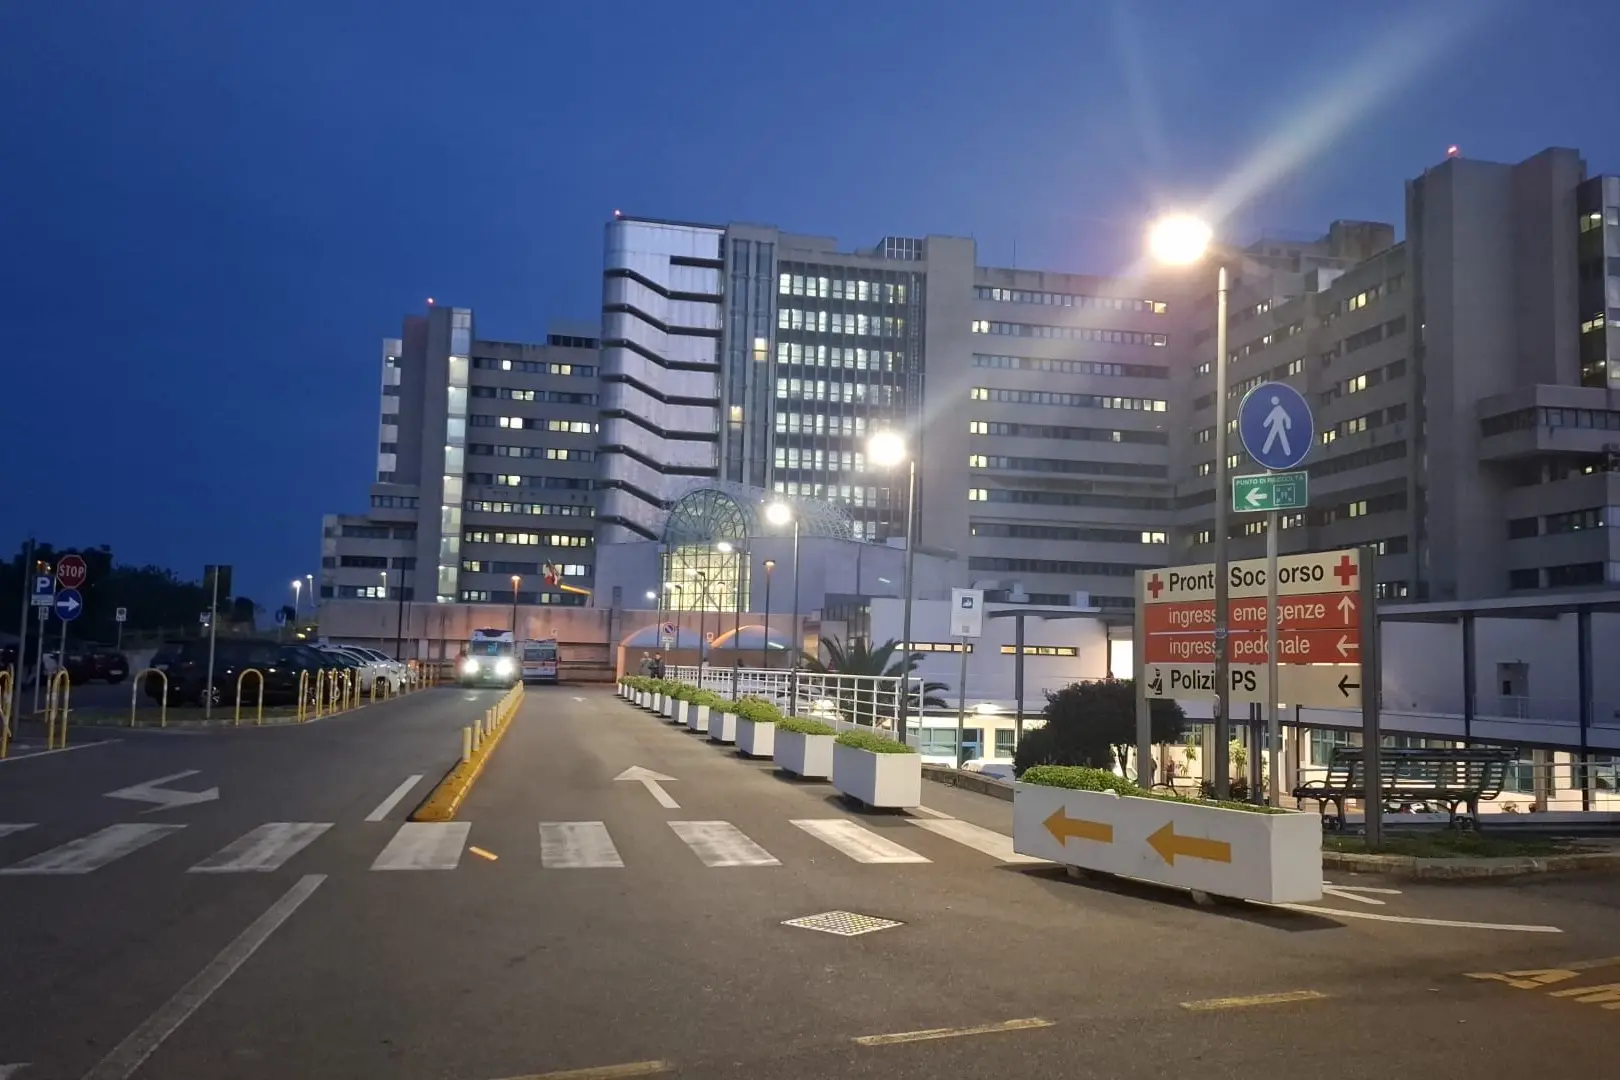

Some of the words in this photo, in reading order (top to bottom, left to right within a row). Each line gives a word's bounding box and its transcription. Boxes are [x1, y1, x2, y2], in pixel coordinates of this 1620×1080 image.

[1236, 478, 1258, 486] PUNTO
[1259, 477, 1266, 485] DI
[58, 564, 85, 578] STOP
[1169, 570, 1215, 592] Pront
[1230, 564, 1324, 588] Socorso
[36, 576, 51, 593] P
[1168, 607, 1216, 628] ingress
[1233, 602, 1325, 625] emegenze
[1170, 669, 1215, 690] Polizi
[1231, 670, 1257, 692] PS
